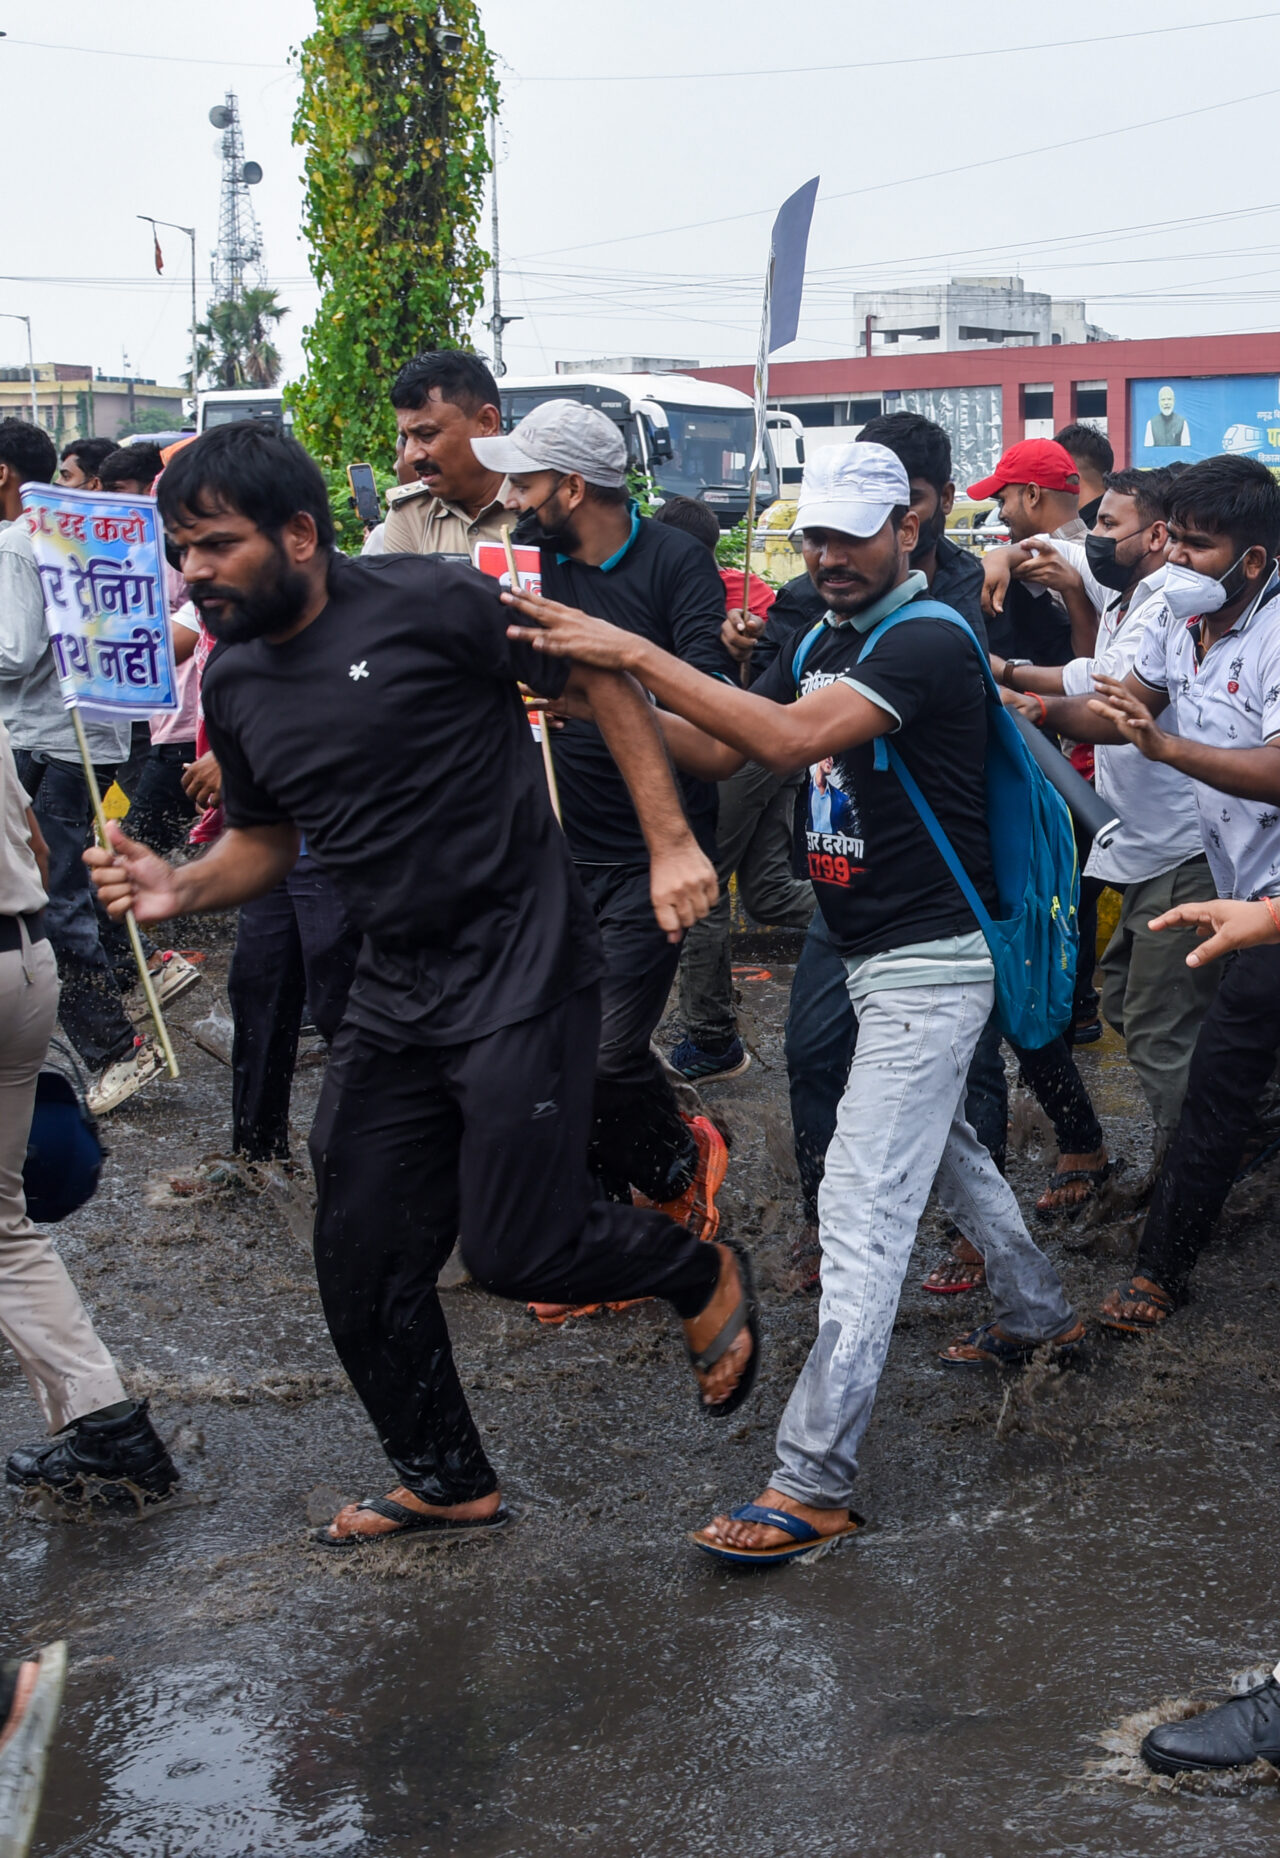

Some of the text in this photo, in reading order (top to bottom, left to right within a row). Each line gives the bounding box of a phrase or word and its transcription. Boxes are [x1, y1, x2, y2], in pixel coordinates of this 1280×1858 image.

[91, 508, 146, 543] करो
[94, 627, 162, 687] नहीं
[822, 830, 864, 859] दरोगा
